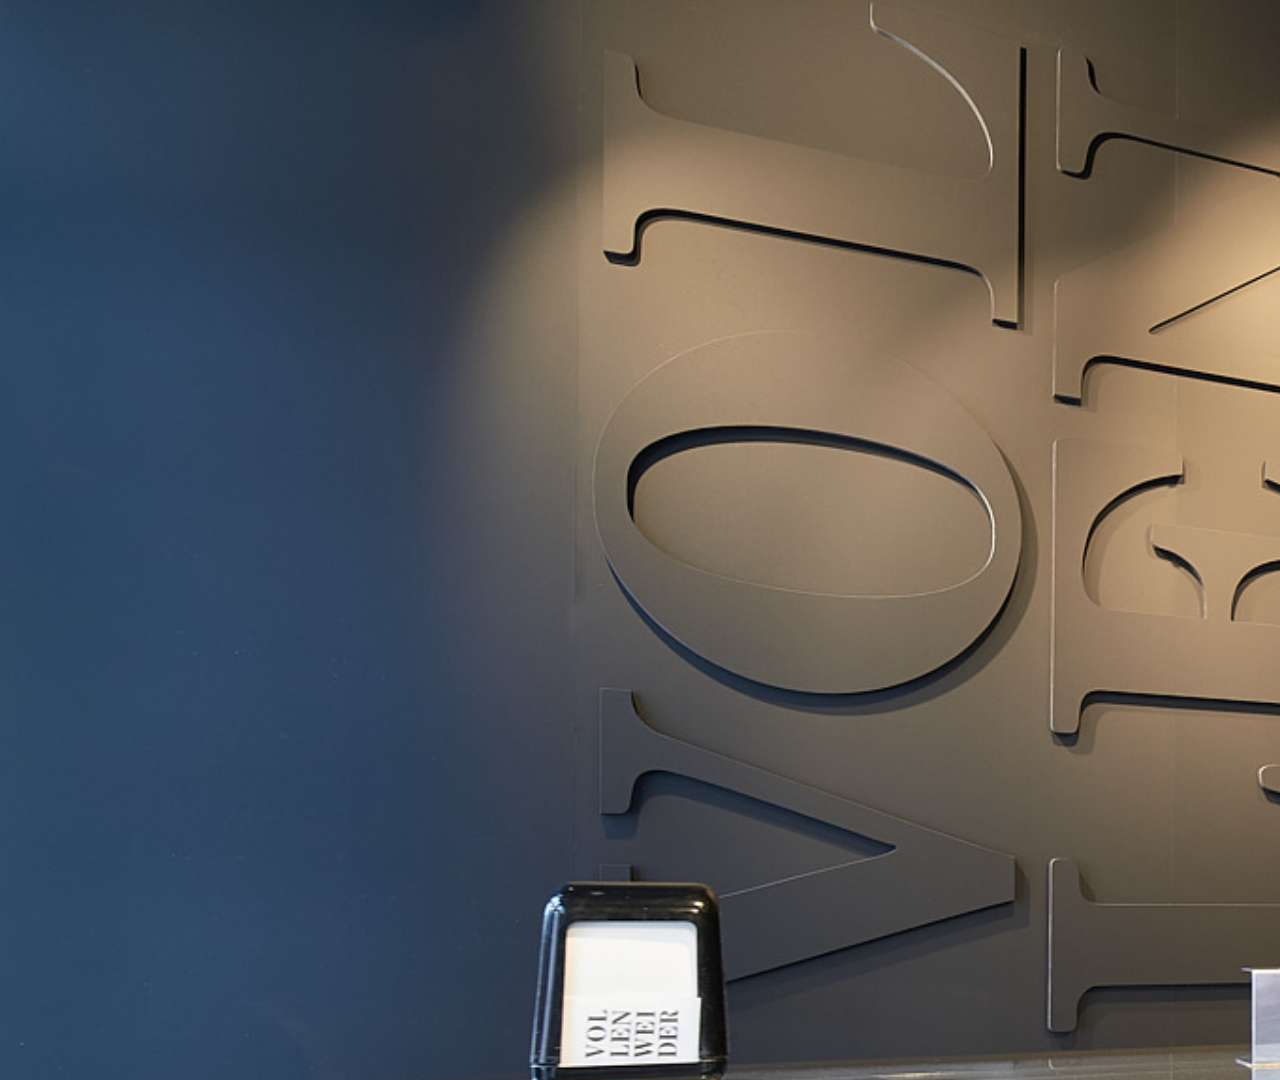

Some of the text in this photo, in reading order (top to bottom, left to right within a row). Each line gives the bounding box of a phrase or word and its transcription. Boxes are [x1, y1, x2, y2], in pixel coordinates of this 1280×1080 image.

[593, 2, 1024, 988] VOL
[585, 1009, 608, 1058] VOL
[610, 1010, 633, 1058] LEN
[633, 1010, 656, 1059] WEI
[657, 1009, 680, 1058] DER
